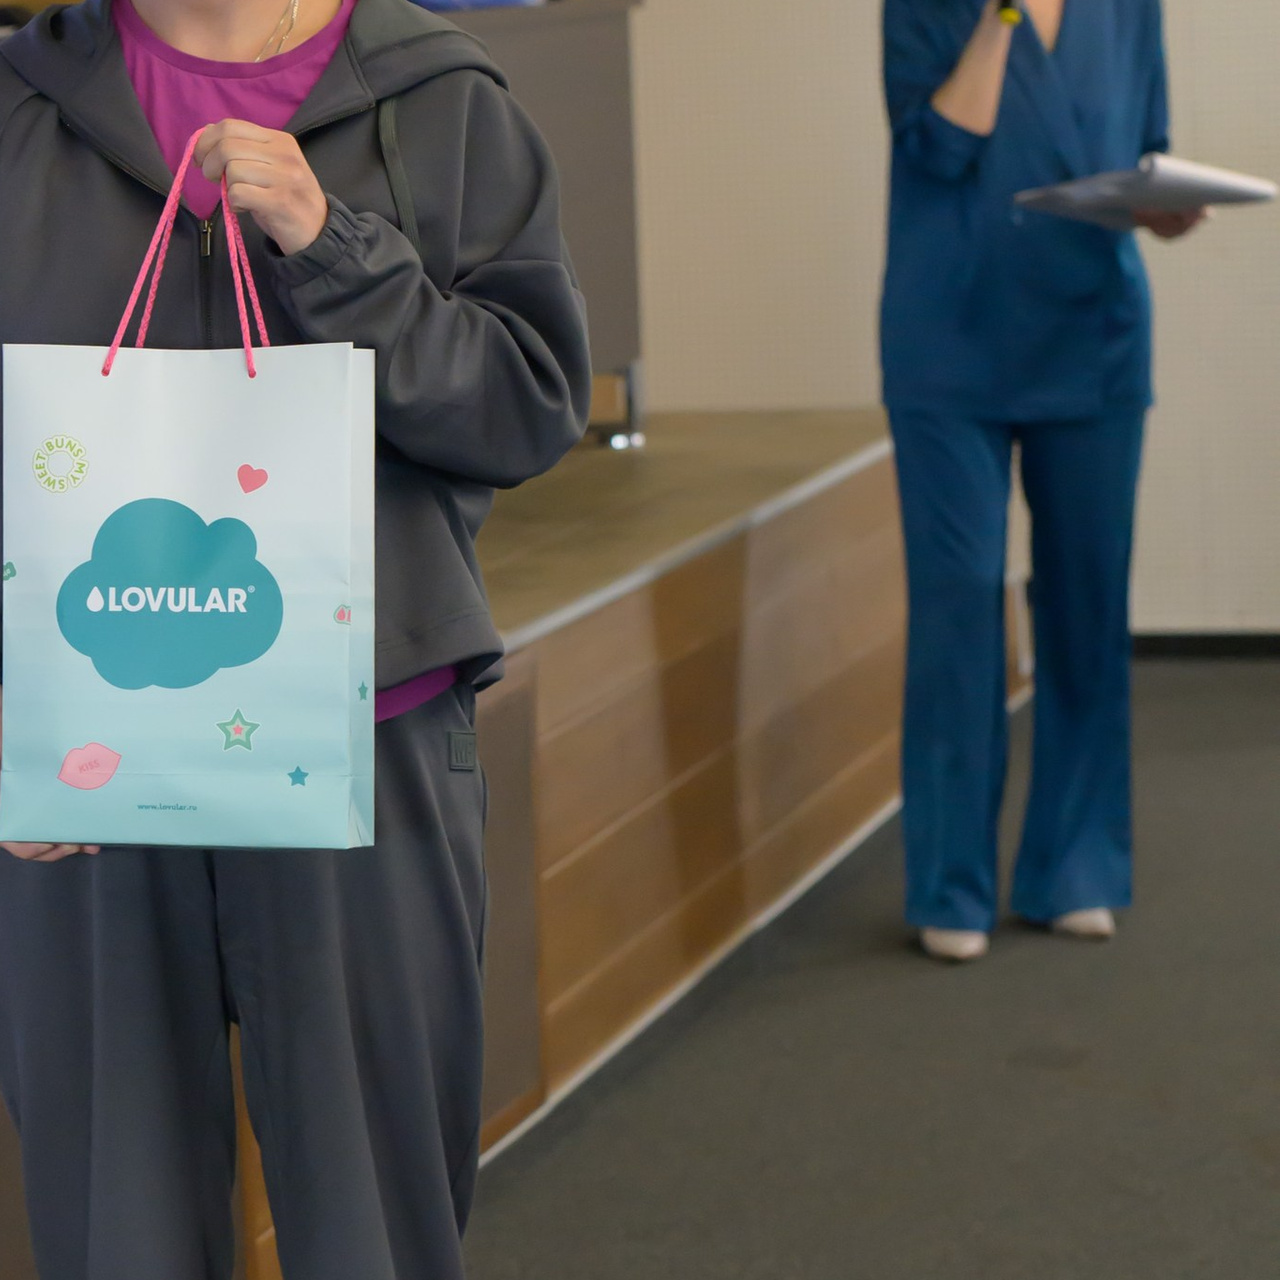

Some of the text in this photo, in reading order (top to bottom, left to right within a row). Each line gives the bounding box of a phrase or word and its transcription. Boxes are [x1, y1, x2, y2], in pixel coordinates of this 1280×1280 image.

[35, 438, 86, 490] MY SWEET BUNS
[108, 586, 248, 613] LOVULAR
[78, 760, 101, 774] KISS
[136, 803, 198, 811] www.lovular.ru
